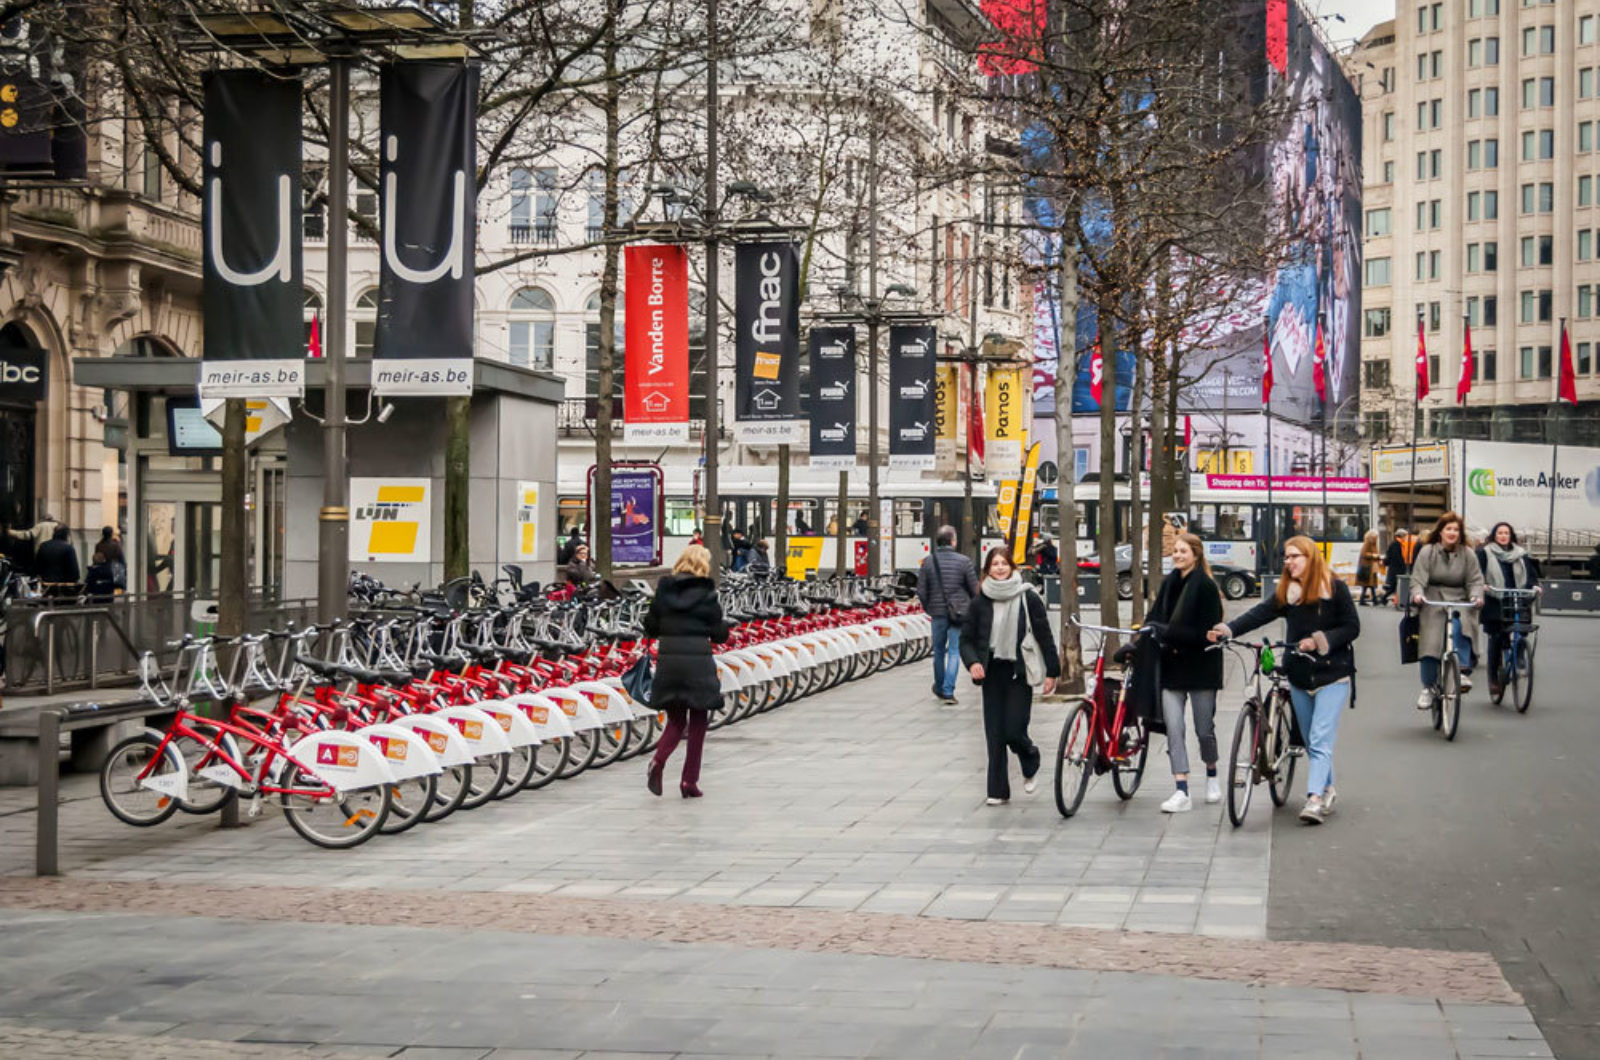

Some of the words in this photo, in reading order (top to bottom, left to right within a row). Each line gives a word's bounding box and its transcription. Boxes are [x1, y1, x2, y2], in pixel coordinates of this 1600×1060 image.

[648, 257, 664, 306] Borre
[751, 252, 781, 344] fnac
[648, 311, 664, 376] Vanden
[207, 368, 299, 384] meir-as.be
[377, 367, 468, 383] meir-as.be
[996, 381, 1010, 438] Panos
[1497, 477, 1514, 487] van
[1516, 475, 1536, 488] den
[321, 747, 333, 761] A
